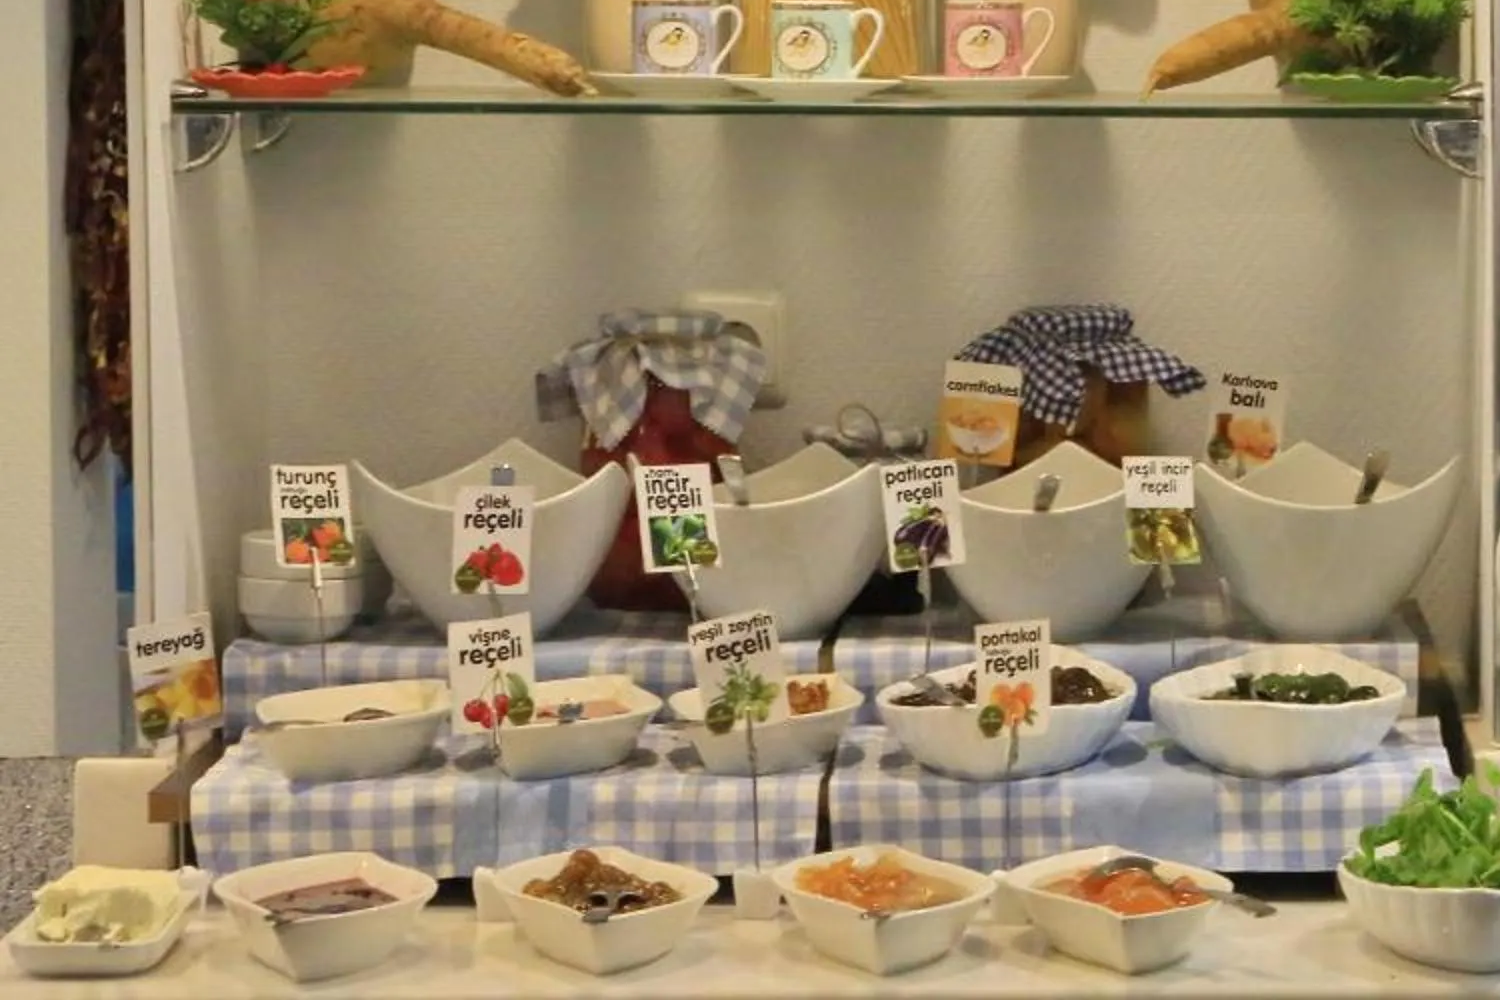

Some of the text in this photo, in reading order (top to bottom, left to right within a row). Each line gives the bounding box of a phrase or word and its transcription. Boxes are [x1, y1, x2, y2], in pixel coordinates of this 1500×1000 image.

[1230, 388, 1265, 409] balı
[276, 468, 337, 488] turunç
[885, 464, 955, 488] patlıcan
[1126, 460, 1157, 478] yeşil
[644, 473, 690, 495] incir
[896, 481, 943, 505] reçeli
[1141, 478, 1177, 497] reçeli
[280, 489, 340, 514] reçeli
[474, 493, 511, 512] çilek
[647, 487, 703, 514] reçeli
[463, 507, 523, 535] reçeli
[468, 628, 512, 647] vişne
[692, 613, 773, 647] yeşil zeytin
[981, 625, 1042, 650] portakal
[459, 636, 523, 669] reçeli
[705, 628, 772, 664] reçeli
[984, 647, 1040, 679] reçeli
